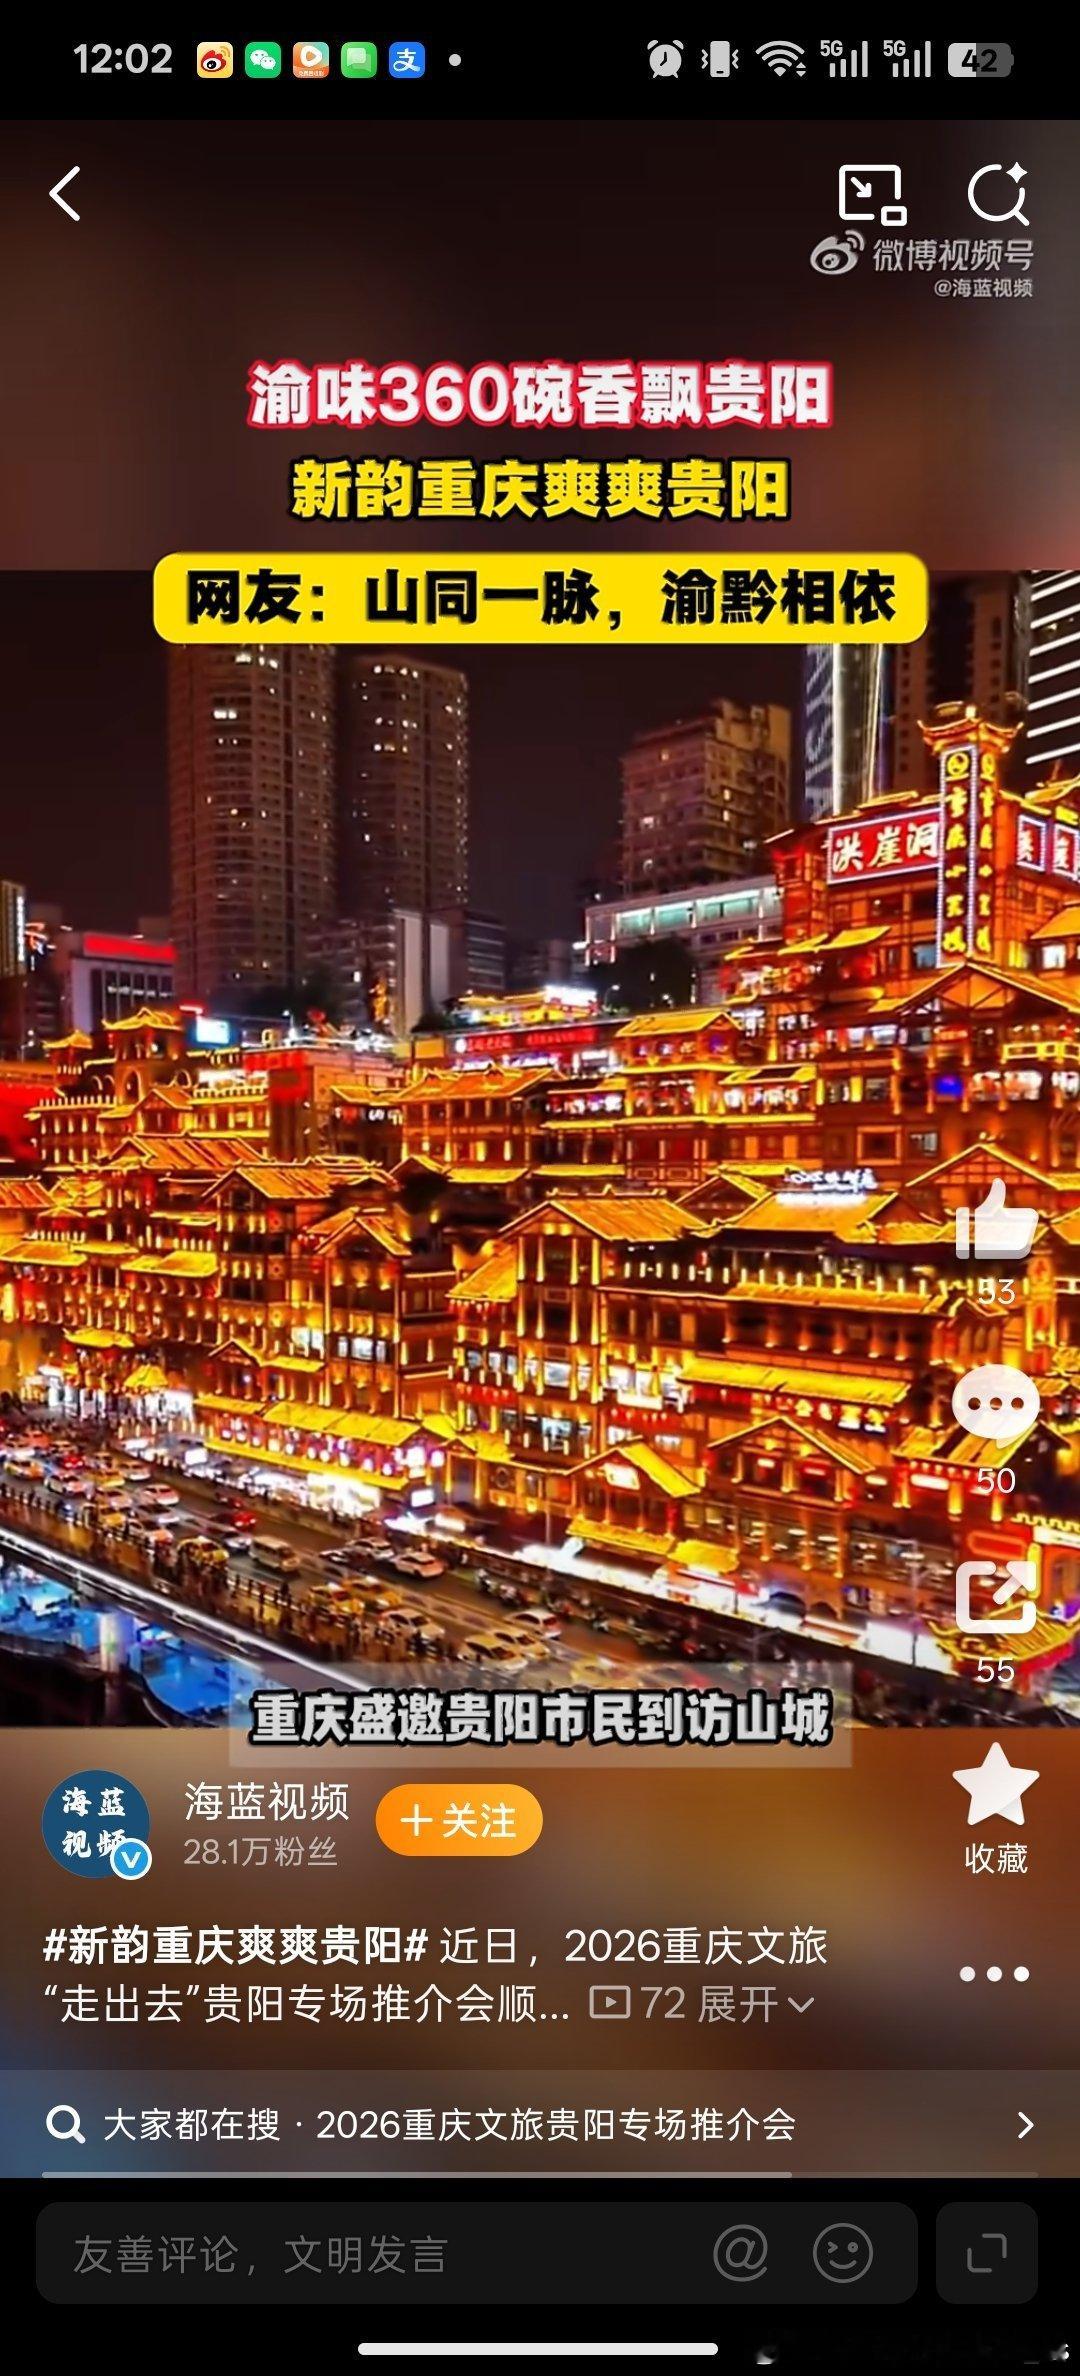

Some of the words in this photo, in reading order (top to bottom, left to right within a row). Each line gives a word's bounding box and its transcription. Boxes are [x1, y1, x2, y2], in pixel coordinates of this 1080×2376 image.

[73, 43, 173, 74] 12:02
[820, 39, 843, 57] 5G
[883, 39, 906, 57] 5G
[961, 48, 998, 73] 42
[832, 822, 939, 873] 洪崖洞
[978, 1279, 1015, 1305] 53
[978, 1467, 1016, 1494] 50
[977, 1656, 1015, 1683] 55
[61, 1786, 126, 1817] 海蓝
[184, 1781, 350, 1821] 海蓝视频
[442, 1803, 516, 1838] 关注
[183, 1835, 339, 1867] 28.1万粉丝
[964, 1842, 1029, 1875] 收藏
[42, 1924, 429, 1966] #新韵重庆爽爽贵阳#
[440, 1925, 828, 1967] 近日，2026重庆文旅
[640, 1985, 686, 2019] 72
[698, 1984, 779, 2023] 展开
[103, 2107, 282, 2142] 大家都在搜
[316, 2107, 797, 2142] 2026重庆文旅贵阳专场推介会
[73, 2234, 449, 2276] 友善评论，文明发言
